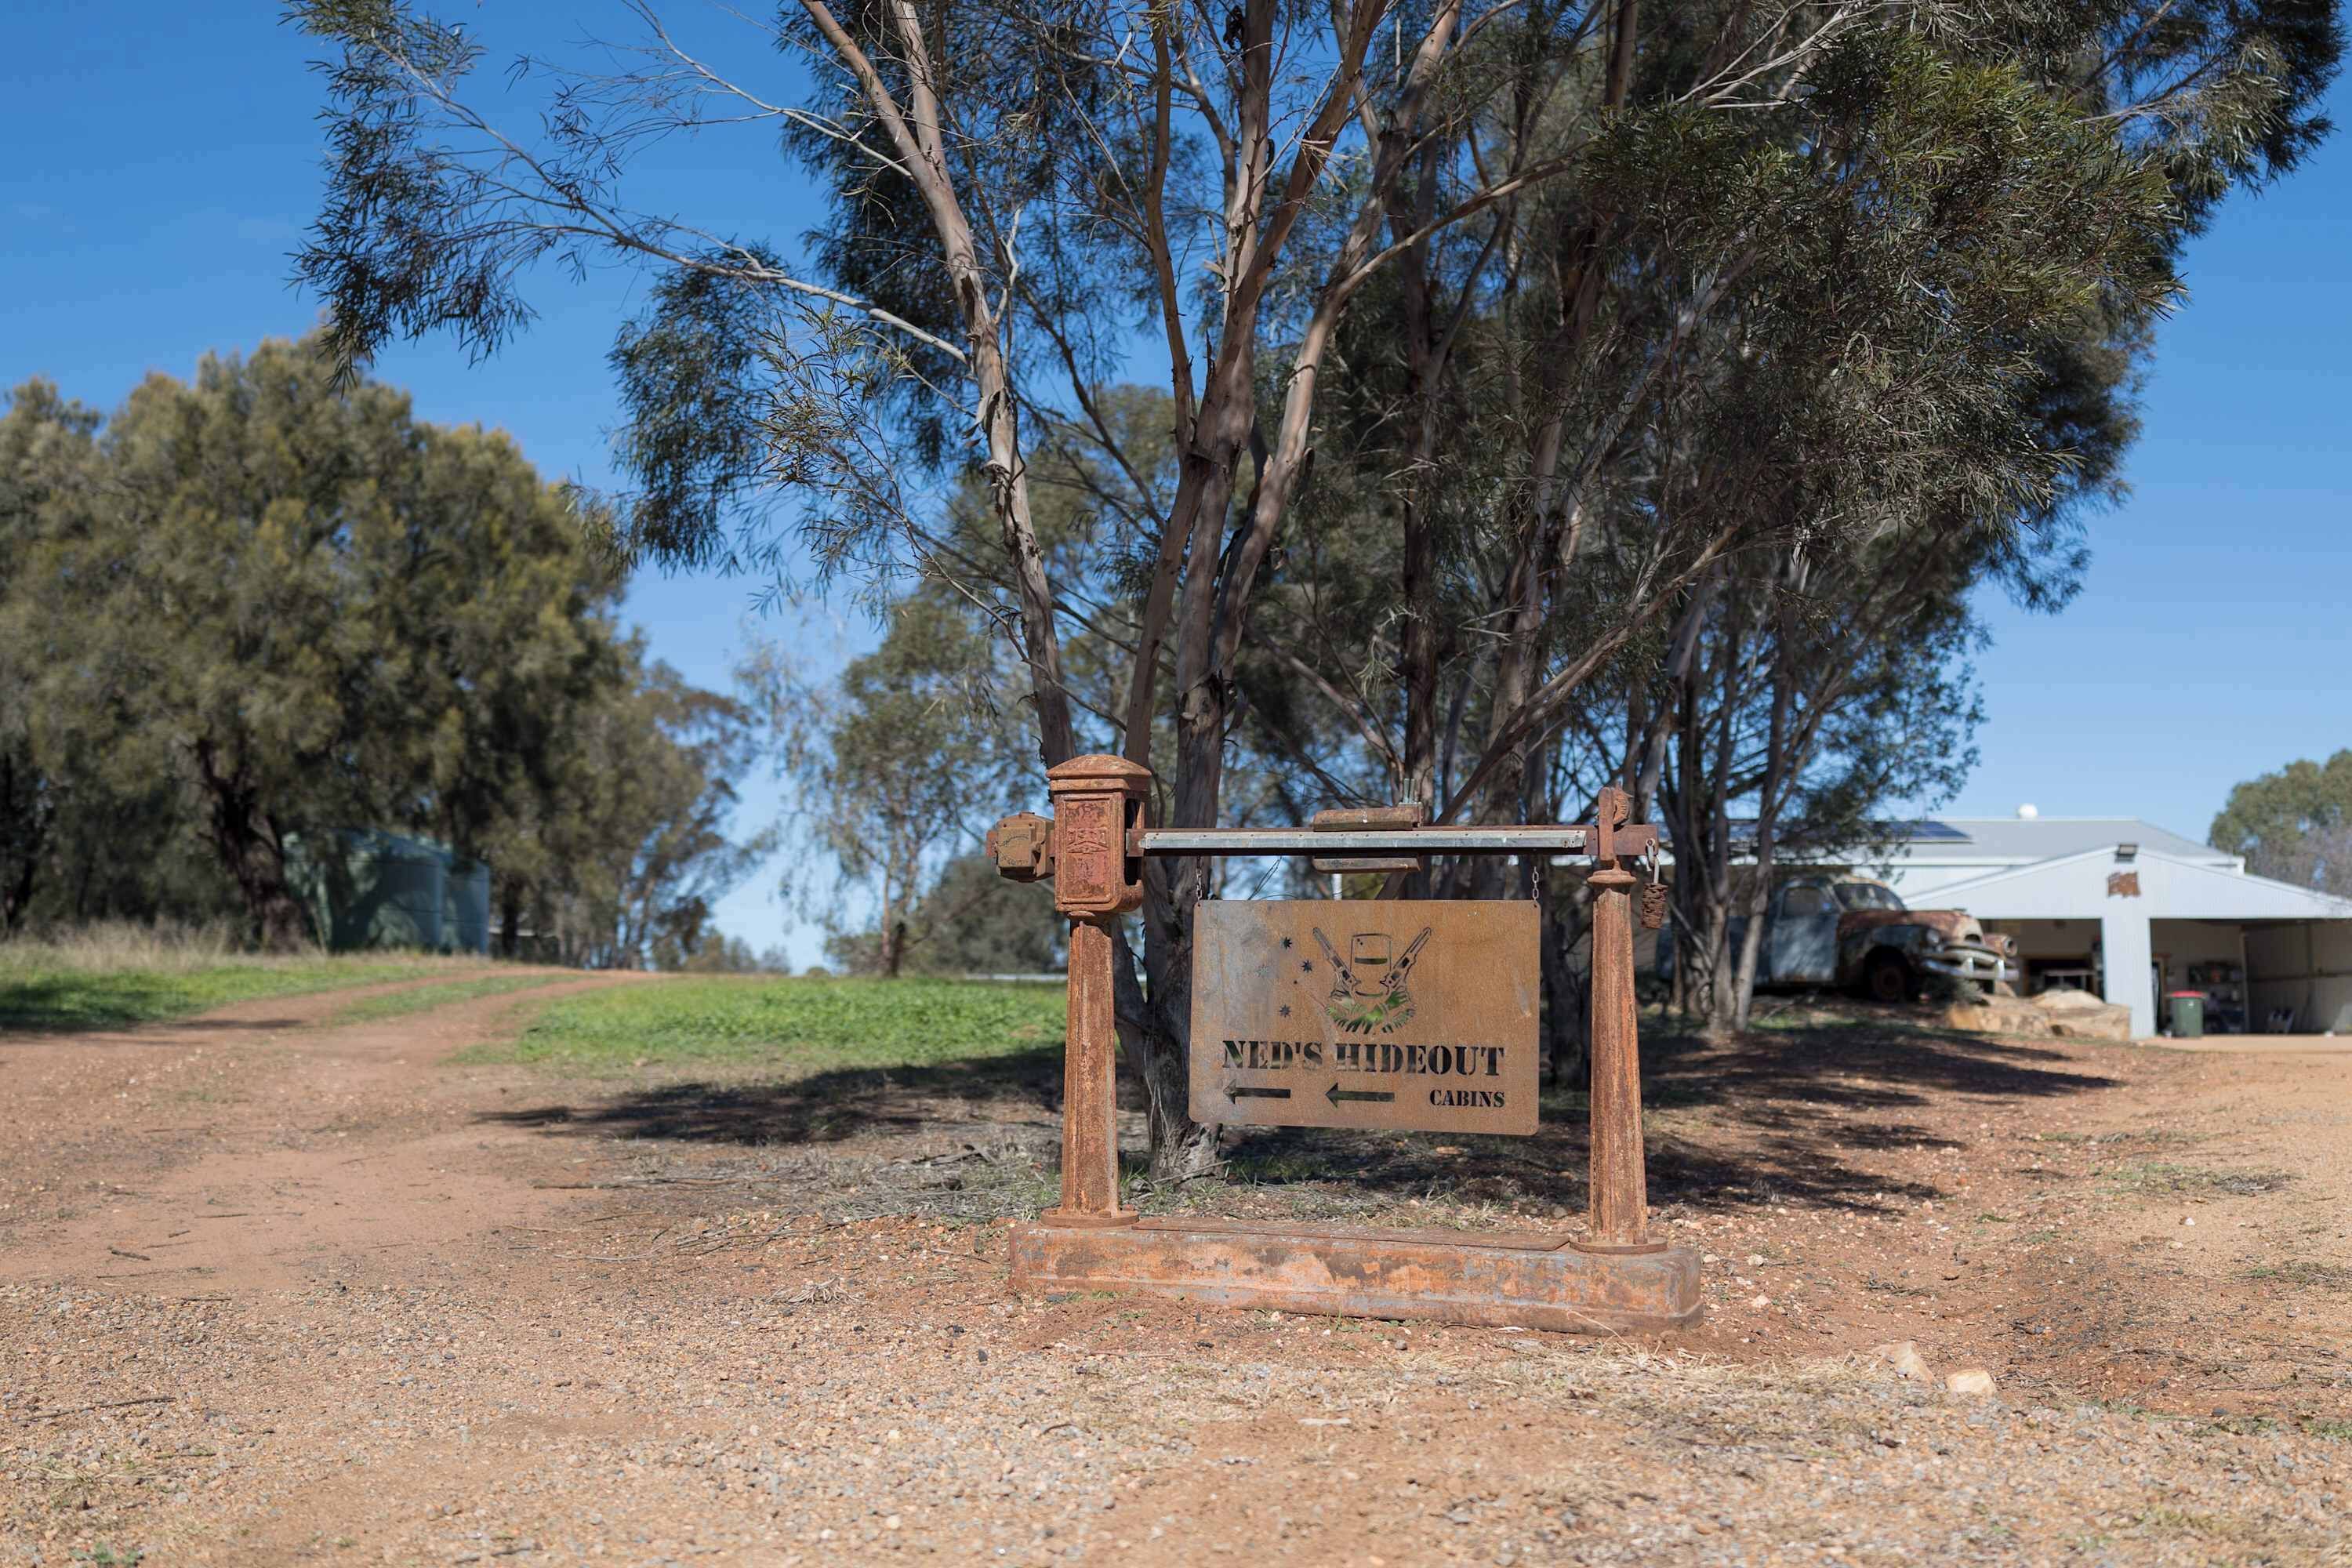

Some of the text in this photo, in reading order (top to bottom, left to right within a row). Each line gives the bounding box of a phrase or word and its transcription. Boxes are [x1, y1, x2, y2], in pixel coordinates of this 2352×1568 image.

[1222, 1040, 1504, 1076] NED'S HIDEOUT
[1429, 1089, 1504, 1108] CABINS
